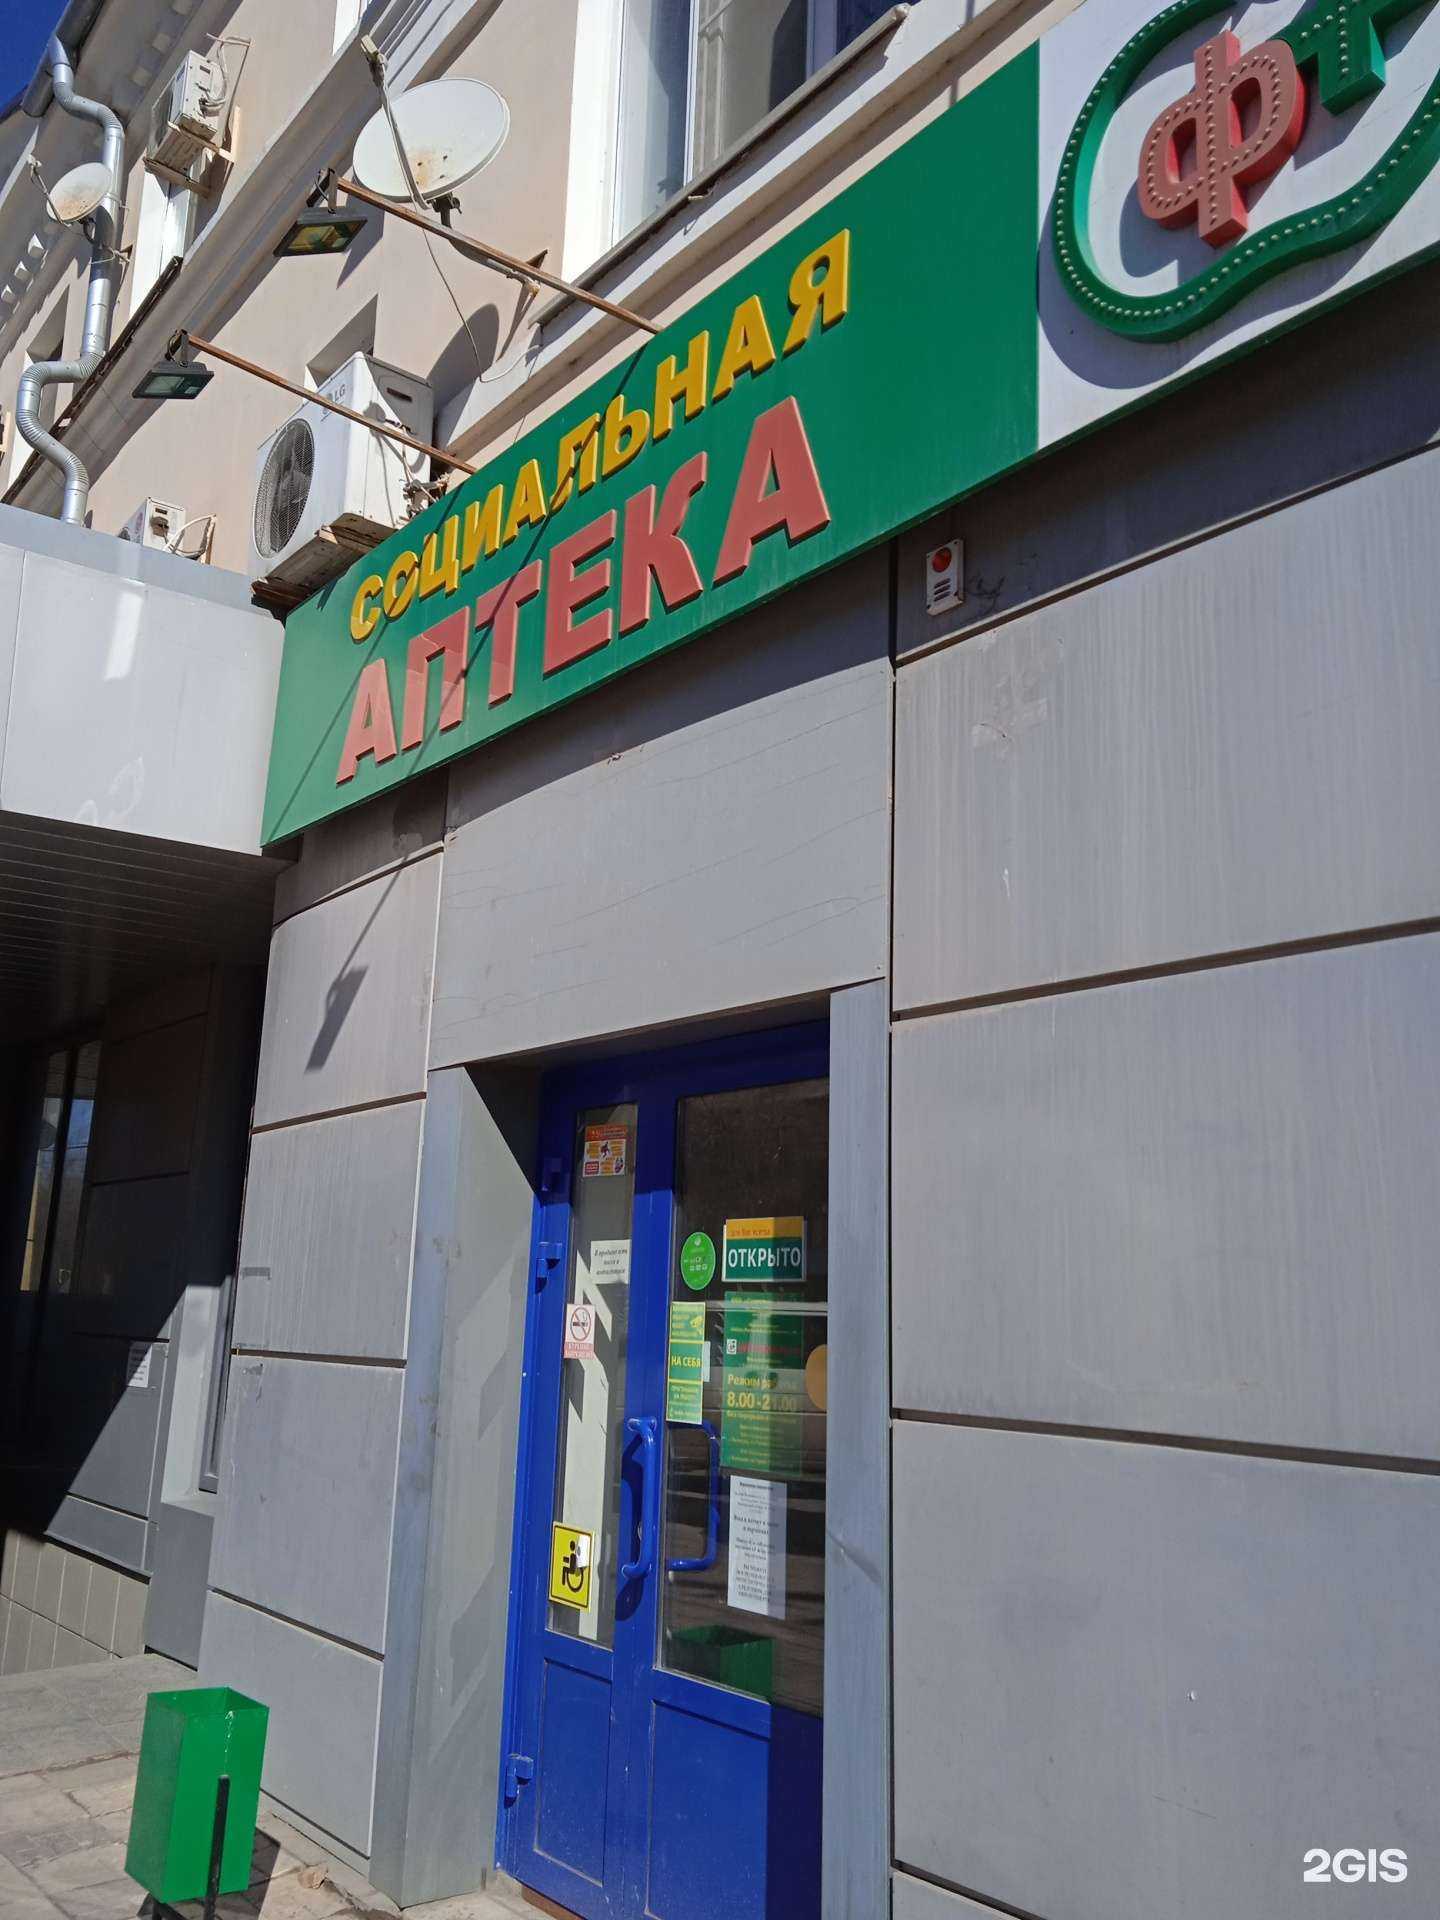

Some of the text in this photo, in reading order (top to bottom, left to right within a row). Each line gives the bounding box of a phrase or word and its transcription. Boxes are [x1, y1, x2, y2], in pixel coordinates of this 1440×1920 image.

[334, 383, 347, 401] LG
[350, 227, 851, 643] СОЦИАЛЬНАЯ
[336, 394, 832, 785] АПТЕКА
[728, 1247, 801, 1268] ОТКРЫТО
[671, 1355, 701, 1368] НА СЕБЯ
